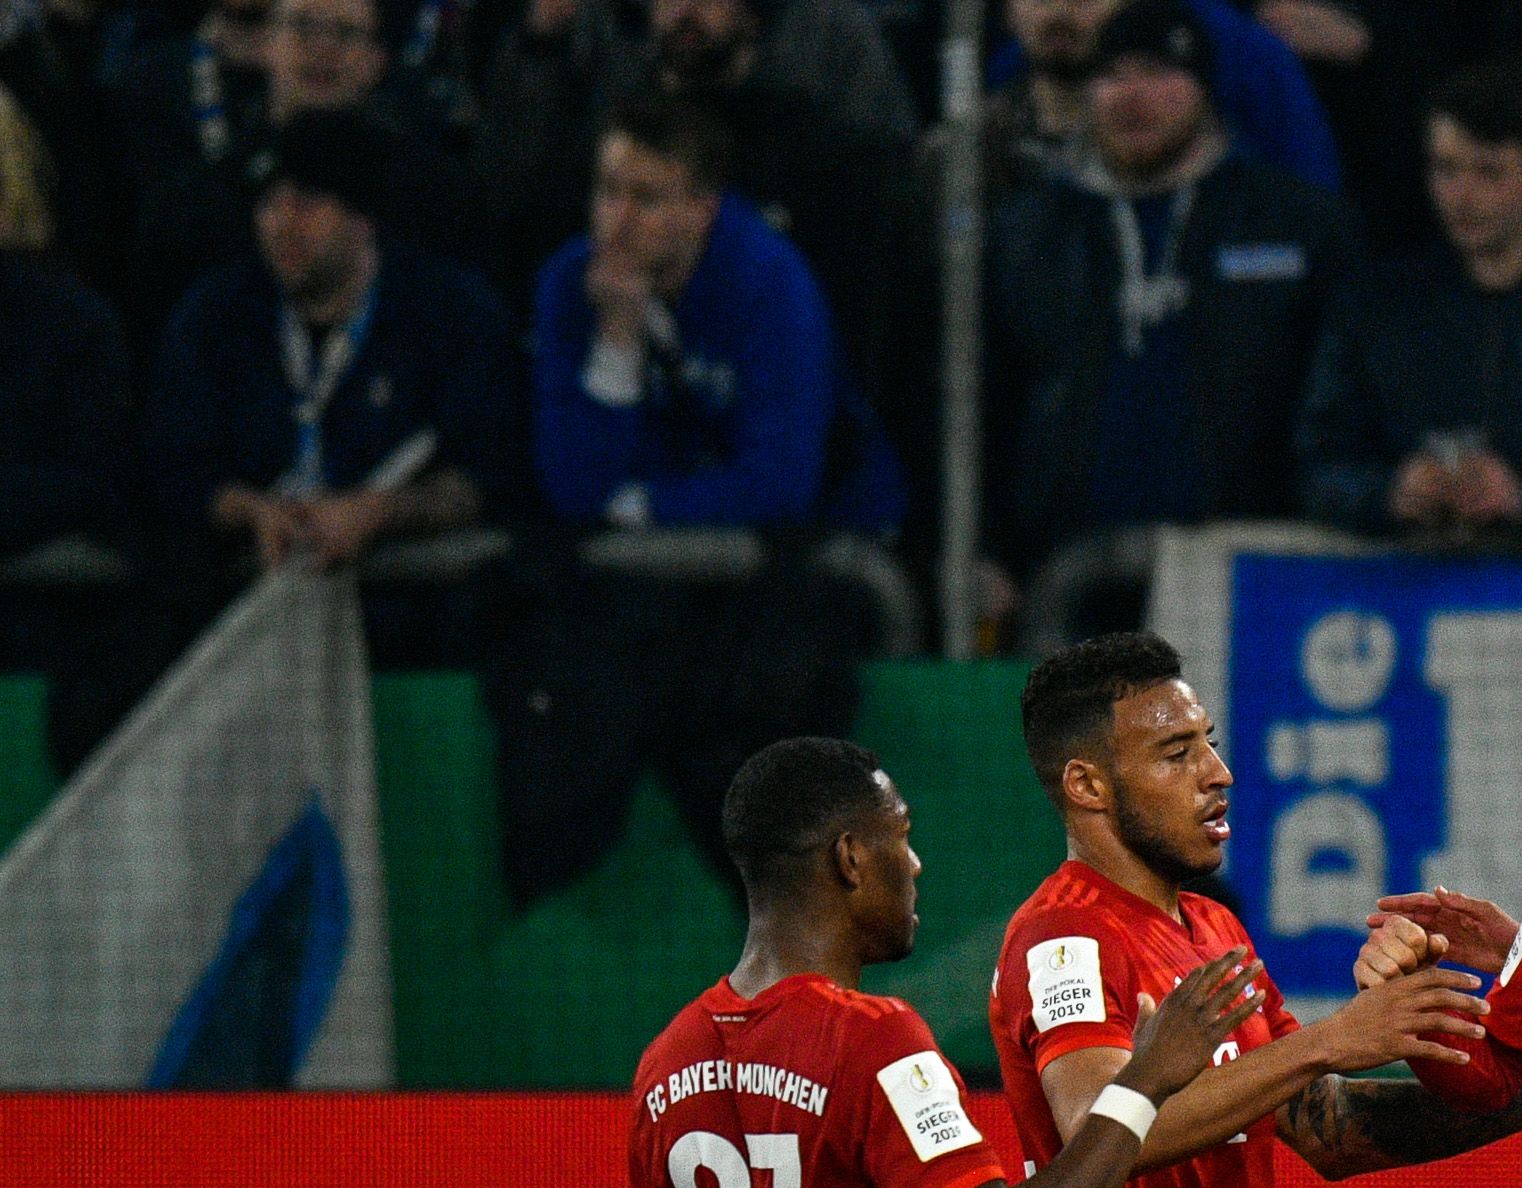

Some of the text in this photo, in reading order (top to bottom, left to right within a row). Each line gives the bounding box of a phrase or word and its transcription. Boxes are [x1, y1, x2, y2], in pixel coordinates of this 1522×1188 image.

[1041, 987, 1092, 1009] SIEGER
[1048, 1002, 1085, 1021] 2019
[646, 1083, 667, 1123] FC
